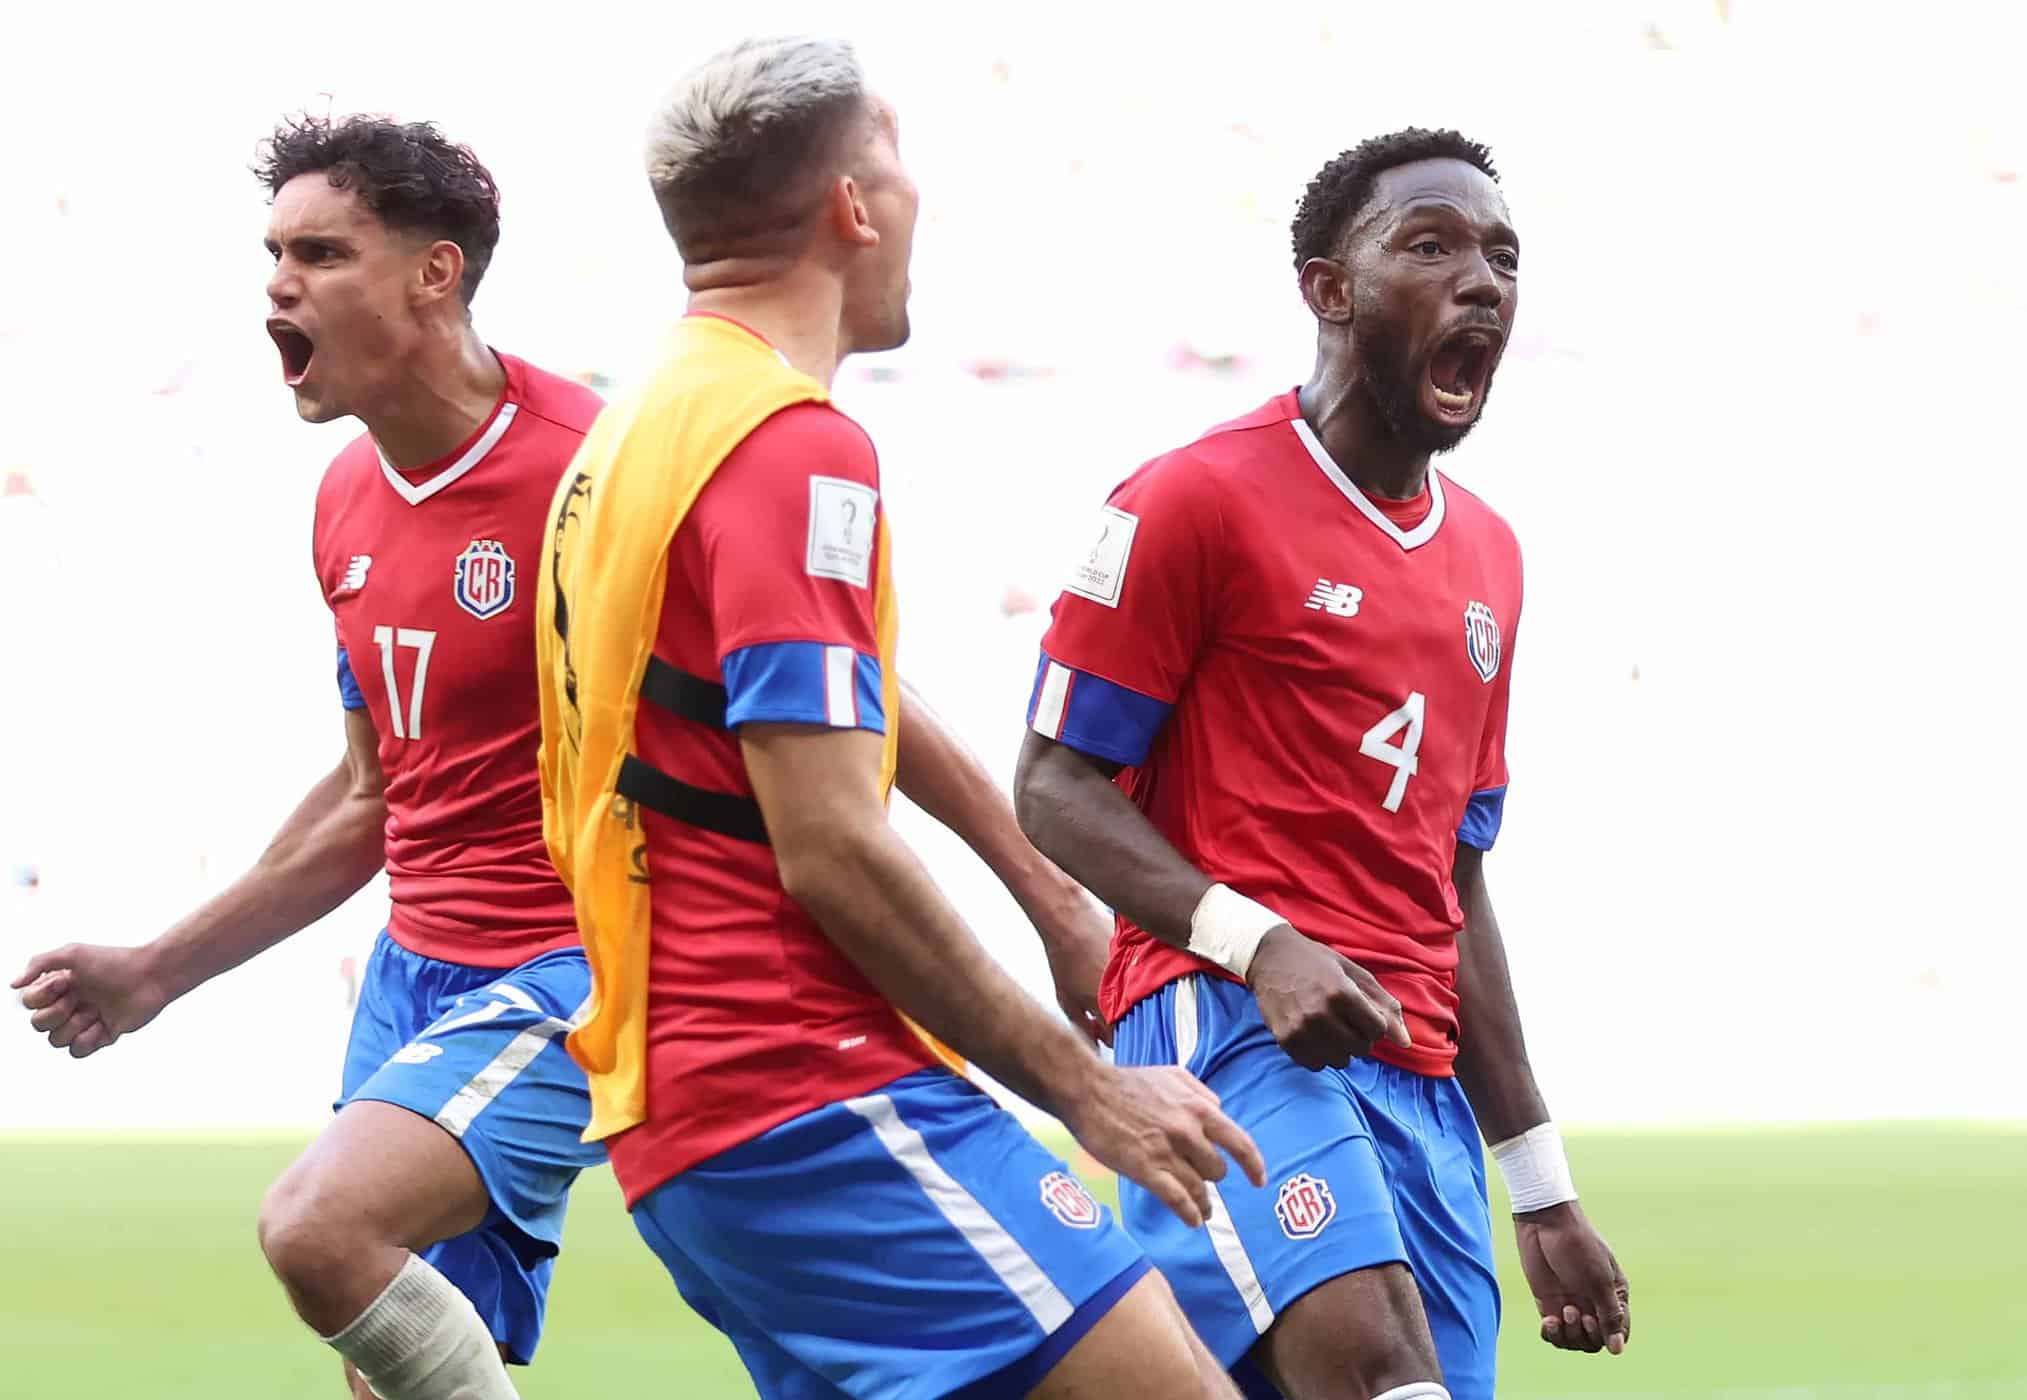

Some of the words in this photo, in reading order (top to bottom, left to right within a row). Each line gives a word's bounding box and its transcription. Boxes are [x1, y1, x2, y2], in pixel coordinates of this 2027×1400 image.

[468, 557, 500, 603] CR
[1473, 618, 1495, 669] CR
[373, 625, 437, 740] 17
[1358, 690, 1425, 814] 4
[1053, 1183, 1090, 1217] CR
[1286, 1186, 1321, 1227] CR
